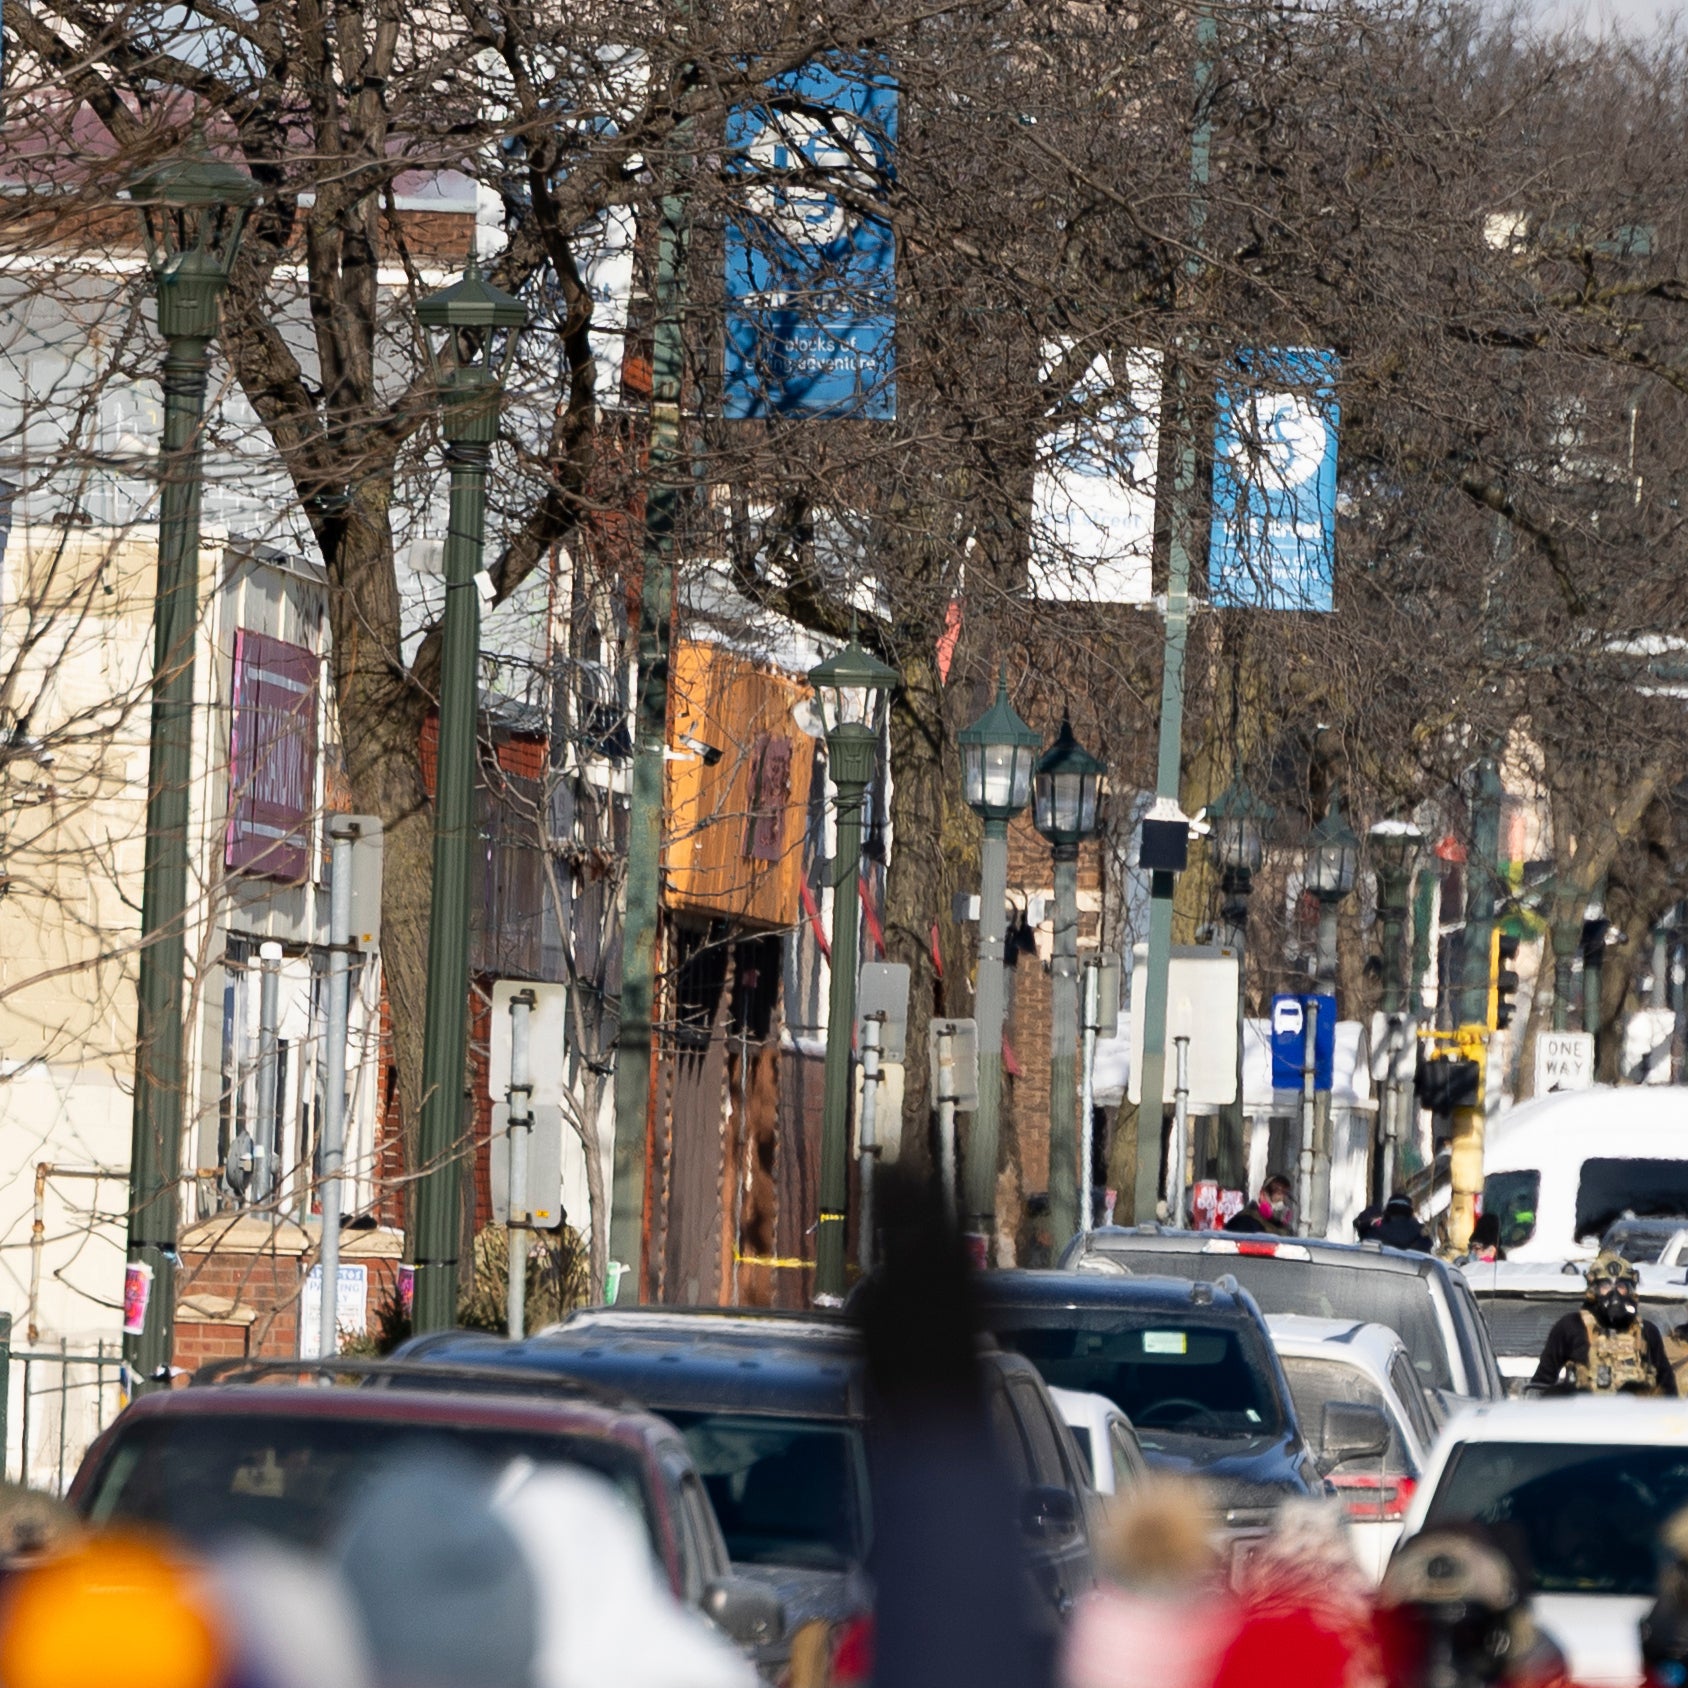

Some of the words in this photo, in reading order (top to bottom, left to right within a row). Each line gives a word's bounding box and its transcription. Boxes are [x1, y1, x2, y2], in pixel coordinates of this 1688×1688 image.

[785, 336, 835, 352] blocks
[798, 355, 876, 371] adventure
[1548, 1041, 1584, 1058] ONE
[1546, 1061, 1583, 1076] WAY
